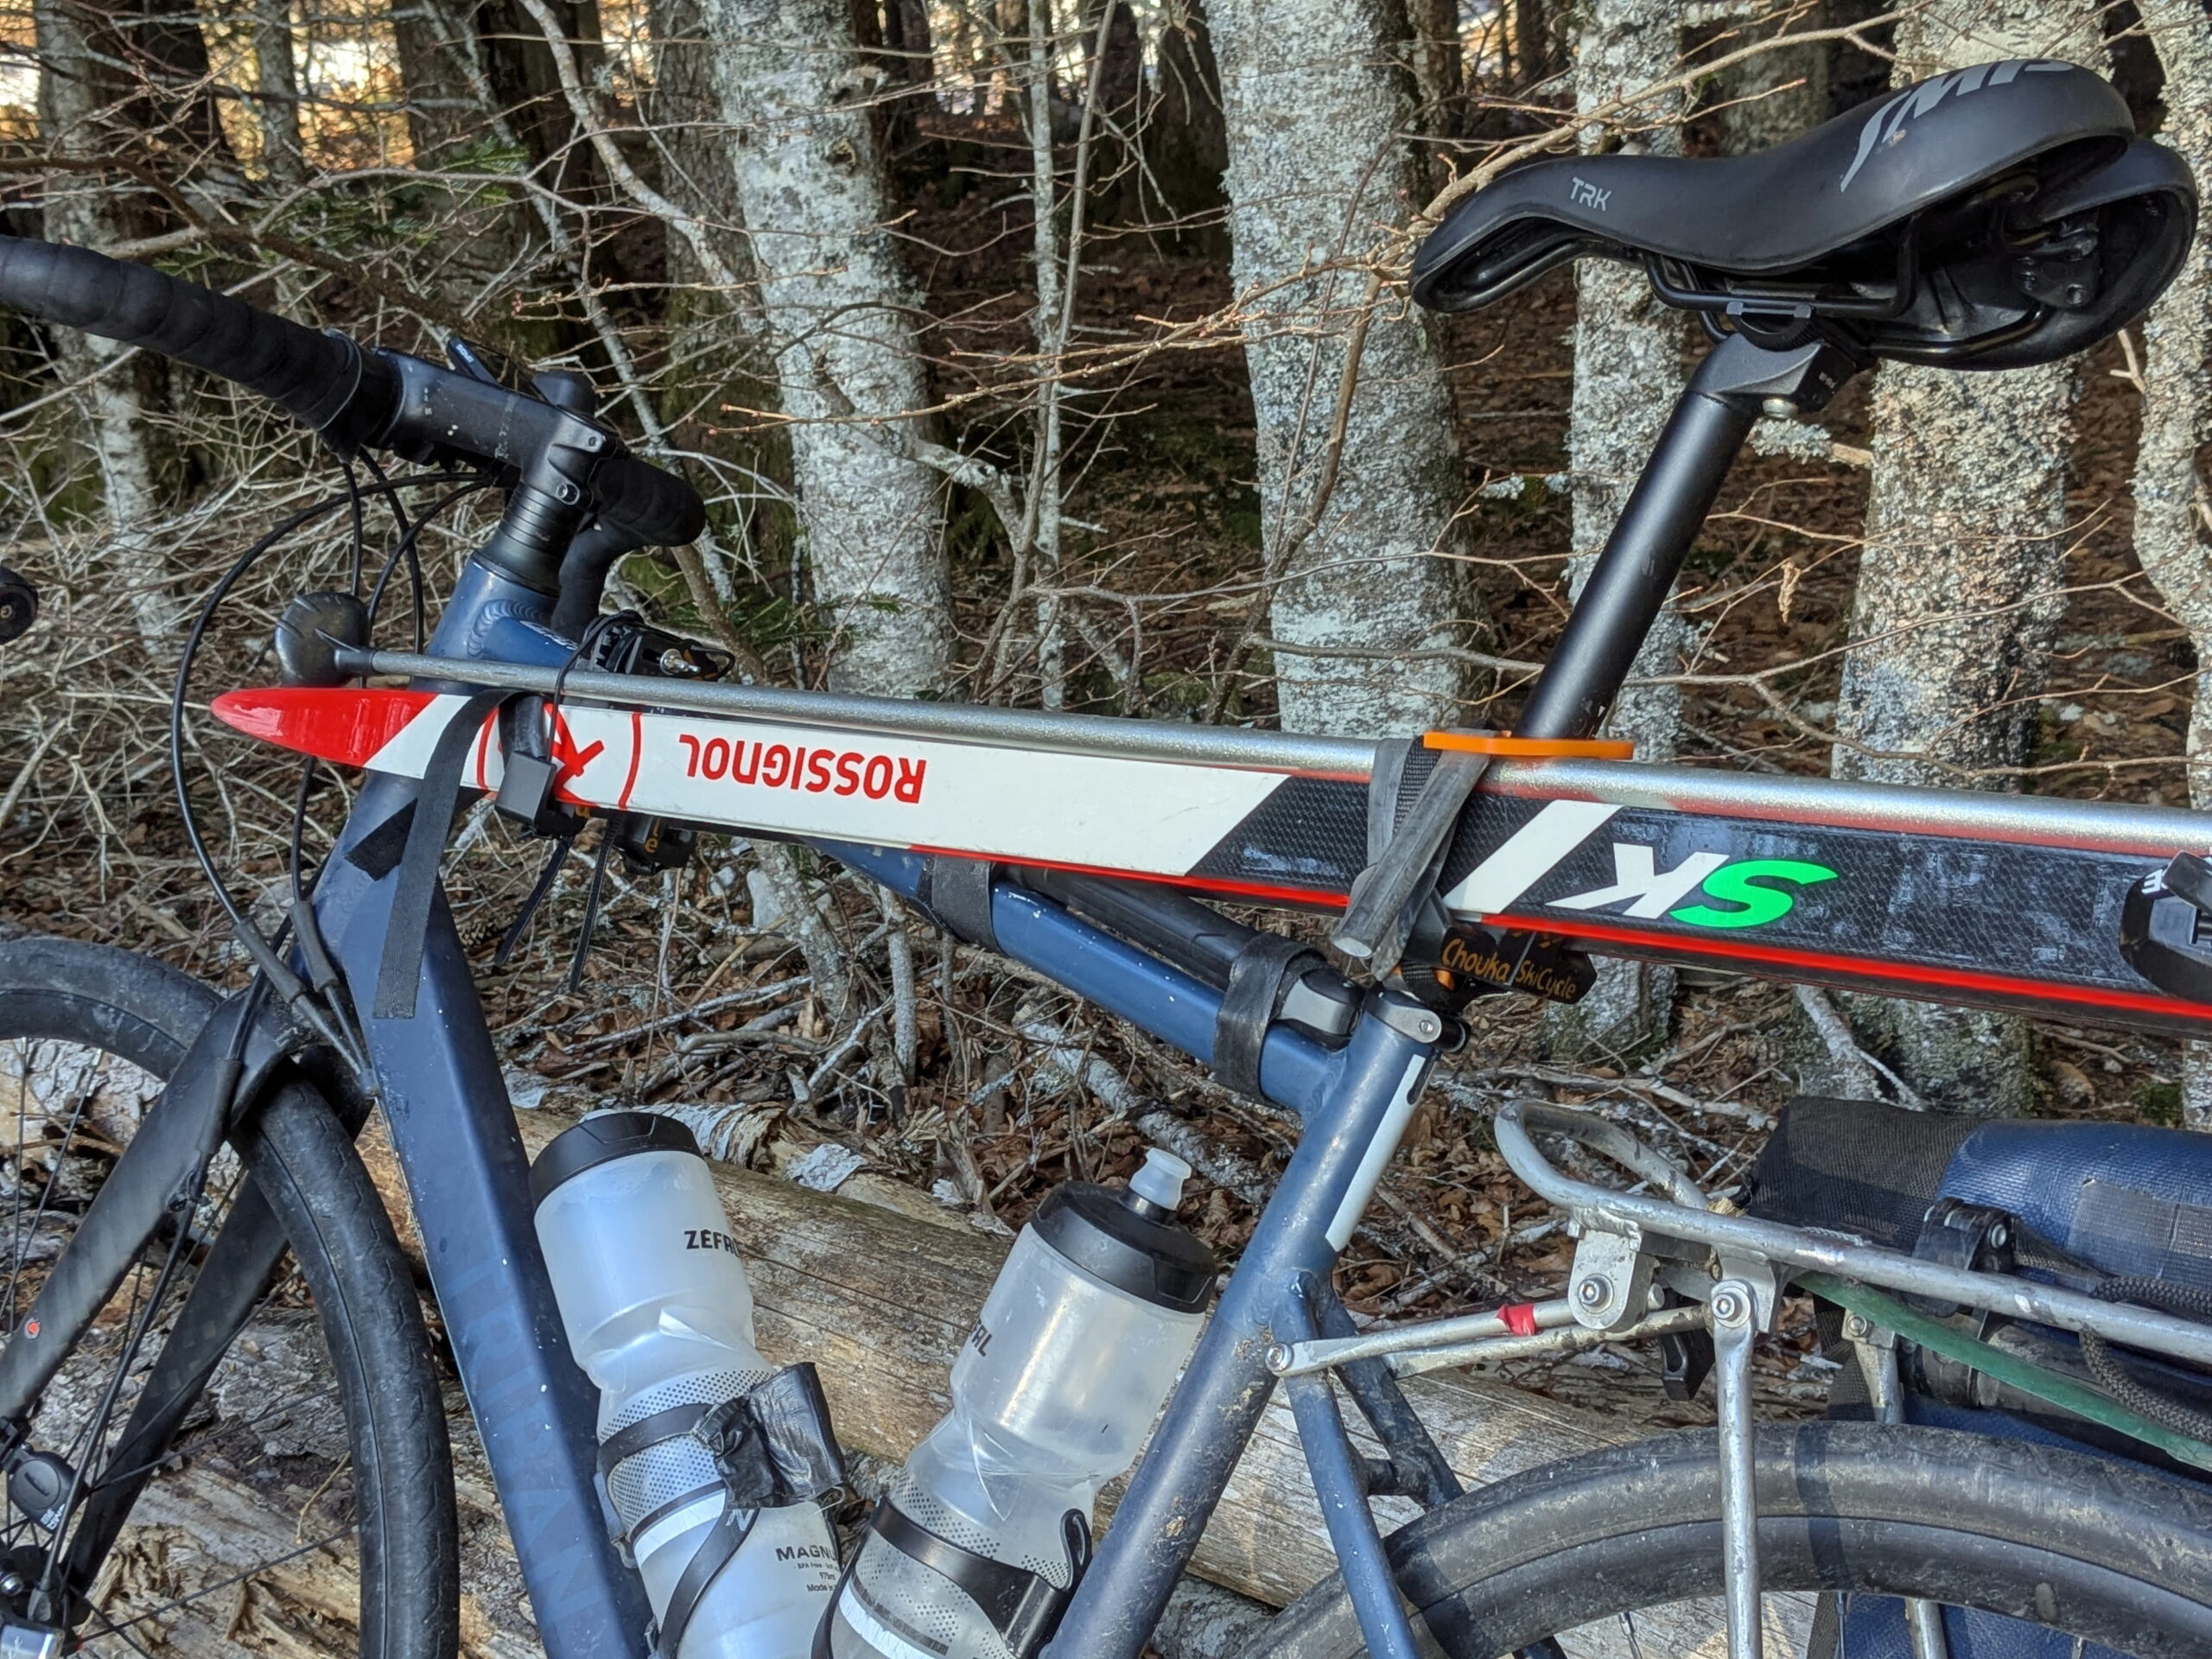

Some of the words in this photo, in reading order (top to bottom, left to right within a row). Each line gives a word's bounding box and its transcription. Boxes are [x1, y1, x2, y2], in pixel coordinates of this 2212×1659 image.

[1570, 176, 1611, 212] TRK
[678, 733, 928, 805] ROSSIGNOL
[1441, 938, 1510, 982] Chouka
[445, 1233, 605, 1626] TRIBAN
[775, 1544, 837, 1562] MAGNU
